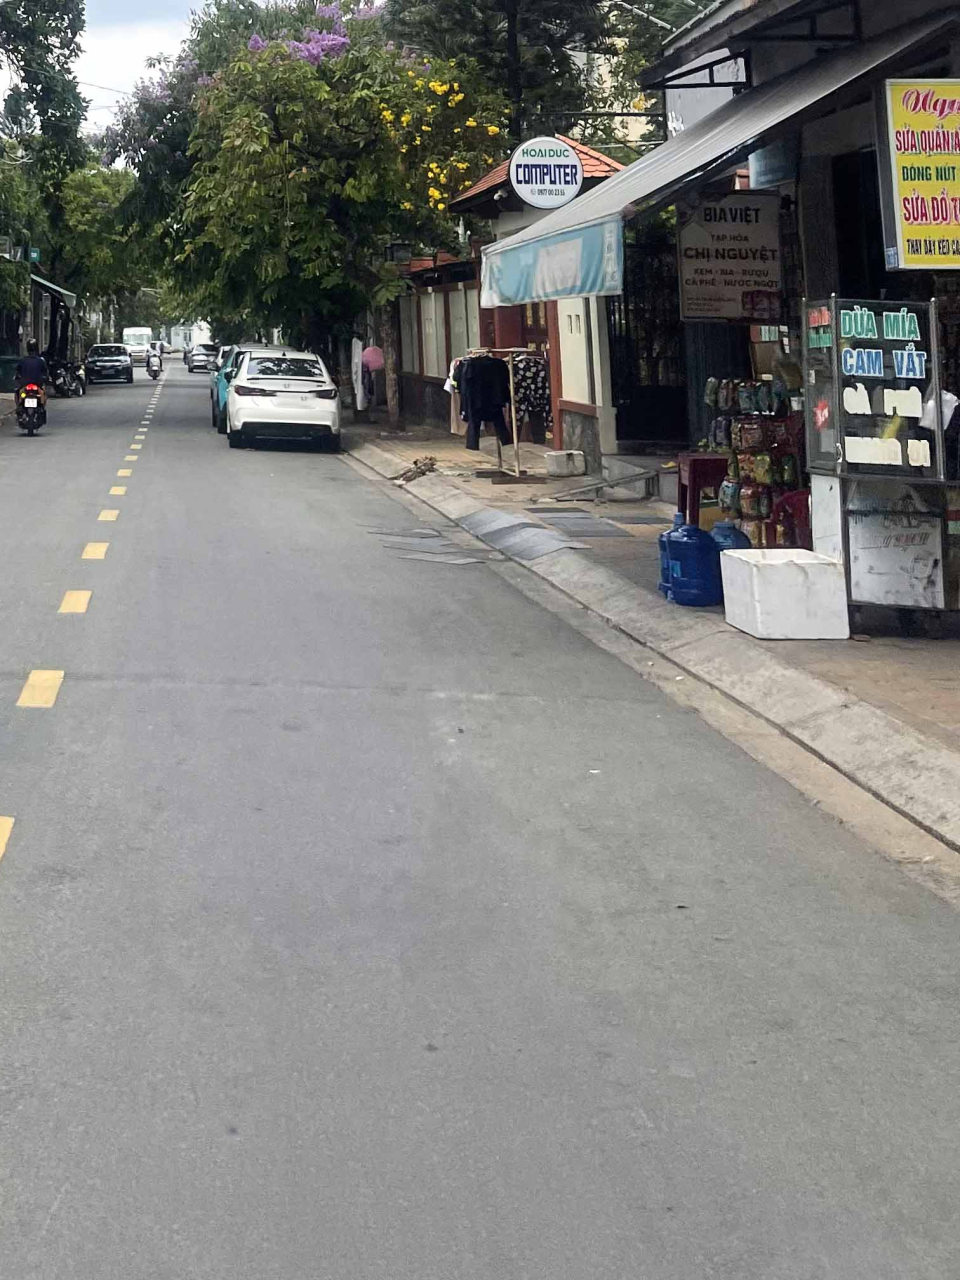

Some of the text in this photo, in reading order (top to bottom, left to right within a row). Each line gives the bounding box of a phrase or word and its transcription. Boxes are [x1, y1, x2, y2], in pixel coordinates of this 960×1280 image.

[895, 123, 917, 151] SỬA
[515, 164, 578, 185] COMPUTER
[703, 206, 761, 226] BIA VIỆT
[902, 188, 928, 221] SỬA
[684, 245, 778, 263] CHỊ NGUYỆT
[840, 305, 878, 339] DỪA
[883, 307, 921, 341] MÍA
[842, 342, 927, 379] CAM VẮT
